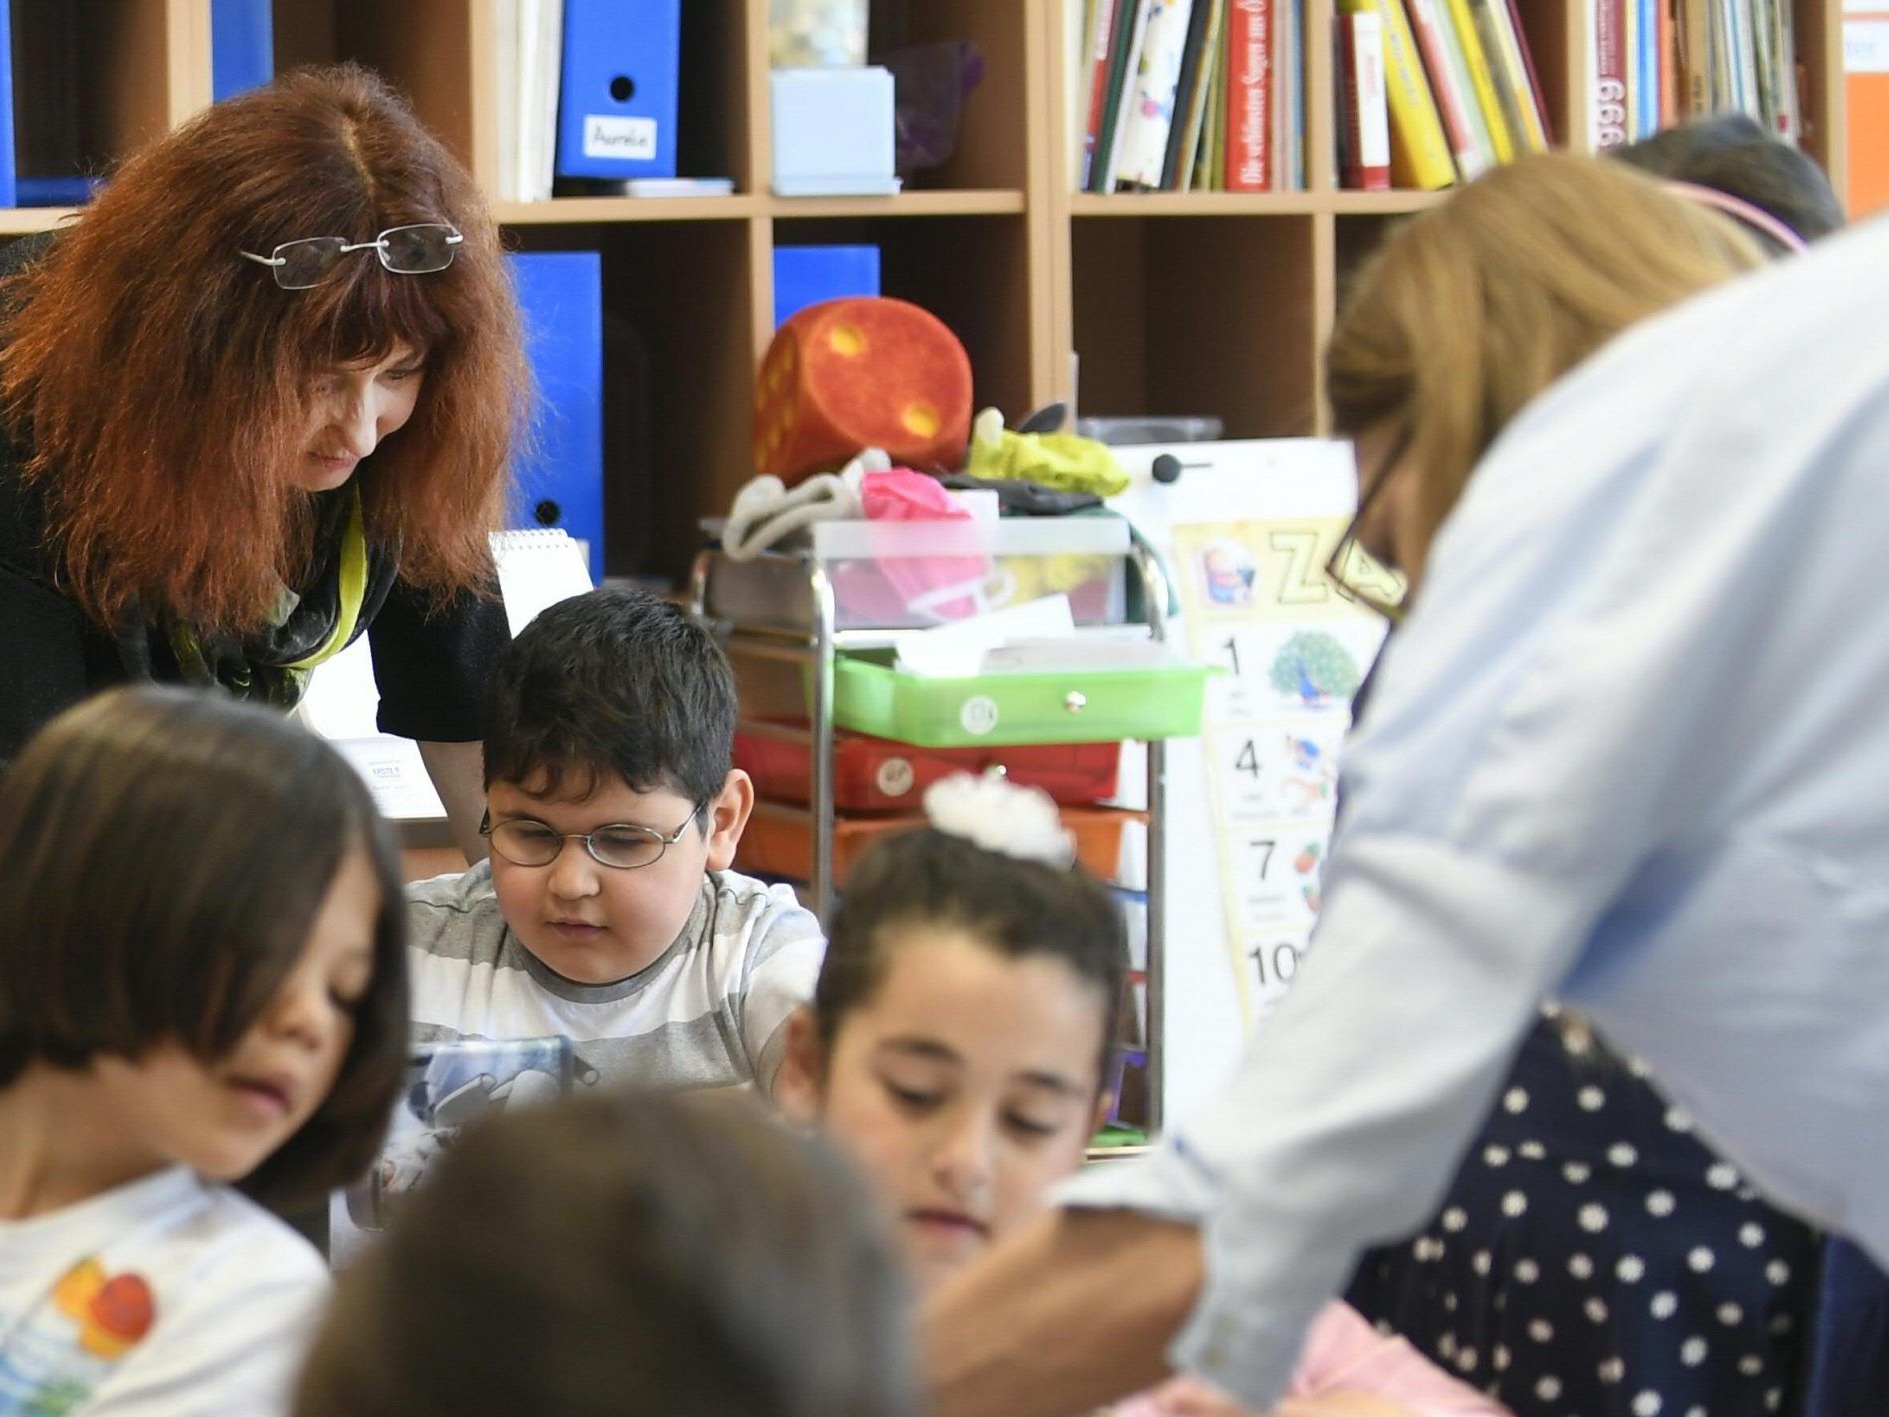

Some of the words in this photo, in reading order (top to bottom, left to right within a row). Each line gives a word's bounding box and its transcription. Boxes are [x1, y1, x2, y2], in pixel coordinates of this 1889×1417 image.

[1235, 739, 1260, 778] 4
[1250, 840, 1276, 880] 7
[1249, 944, 1297, 982] 10
